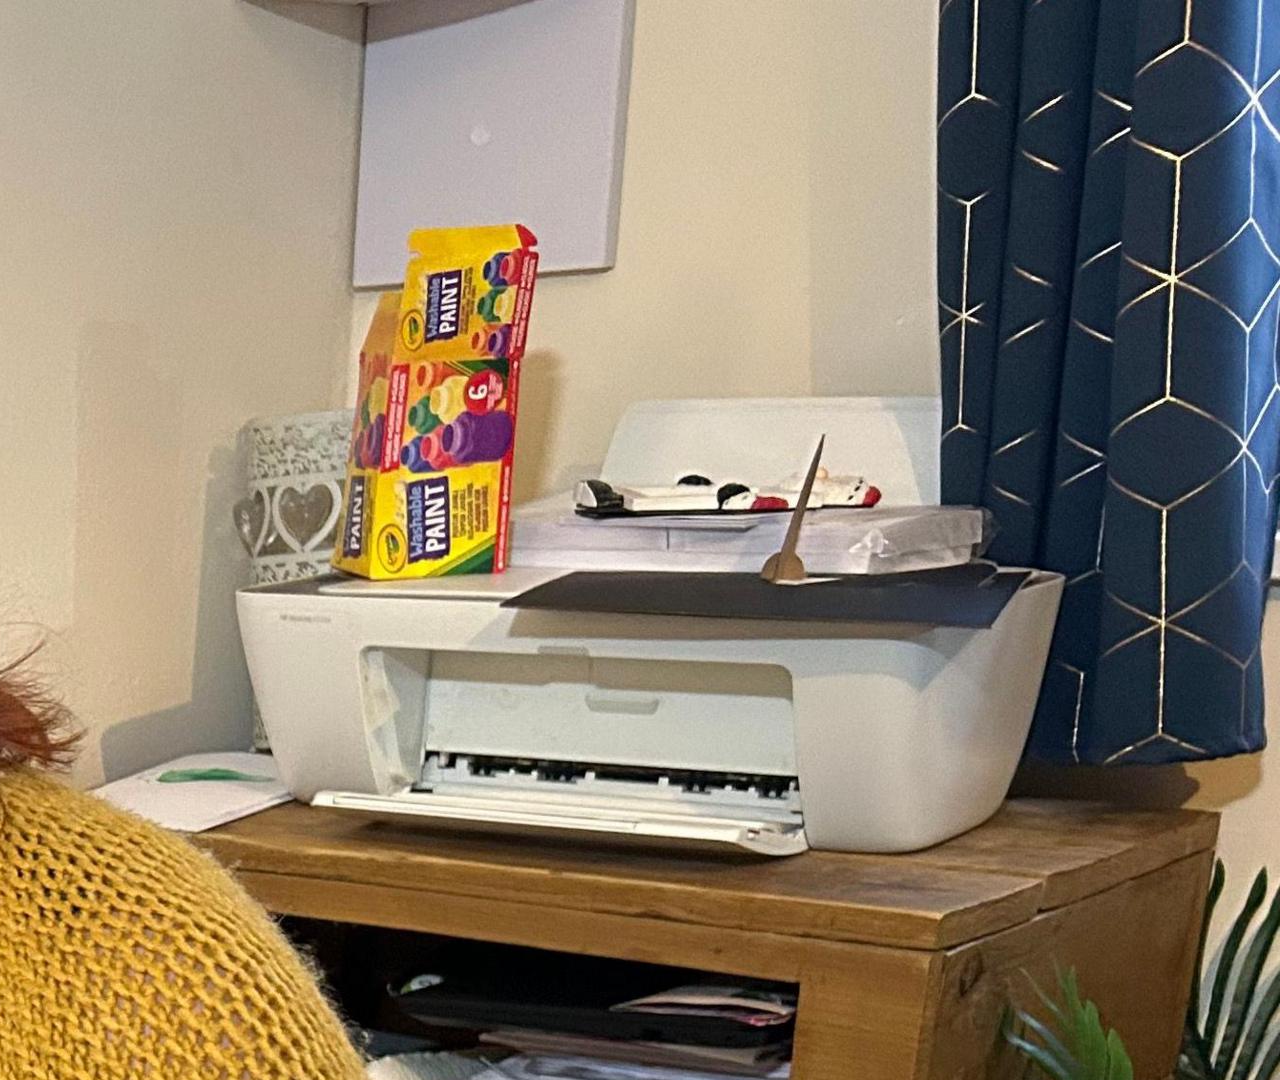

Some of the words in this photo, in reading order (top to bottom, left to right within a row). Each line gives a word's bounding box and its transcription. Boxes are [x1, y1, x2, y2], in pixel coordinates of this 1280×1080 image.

[426, 277, 441, 339] Washable
[439, 276, 459, 334] PAINT
[468, 384, 488, 400] 6
[350, 485, 364, 550] PAINT
[409, 485, 423, 558] Washable
[424, 484, 446, 553] PAINT
